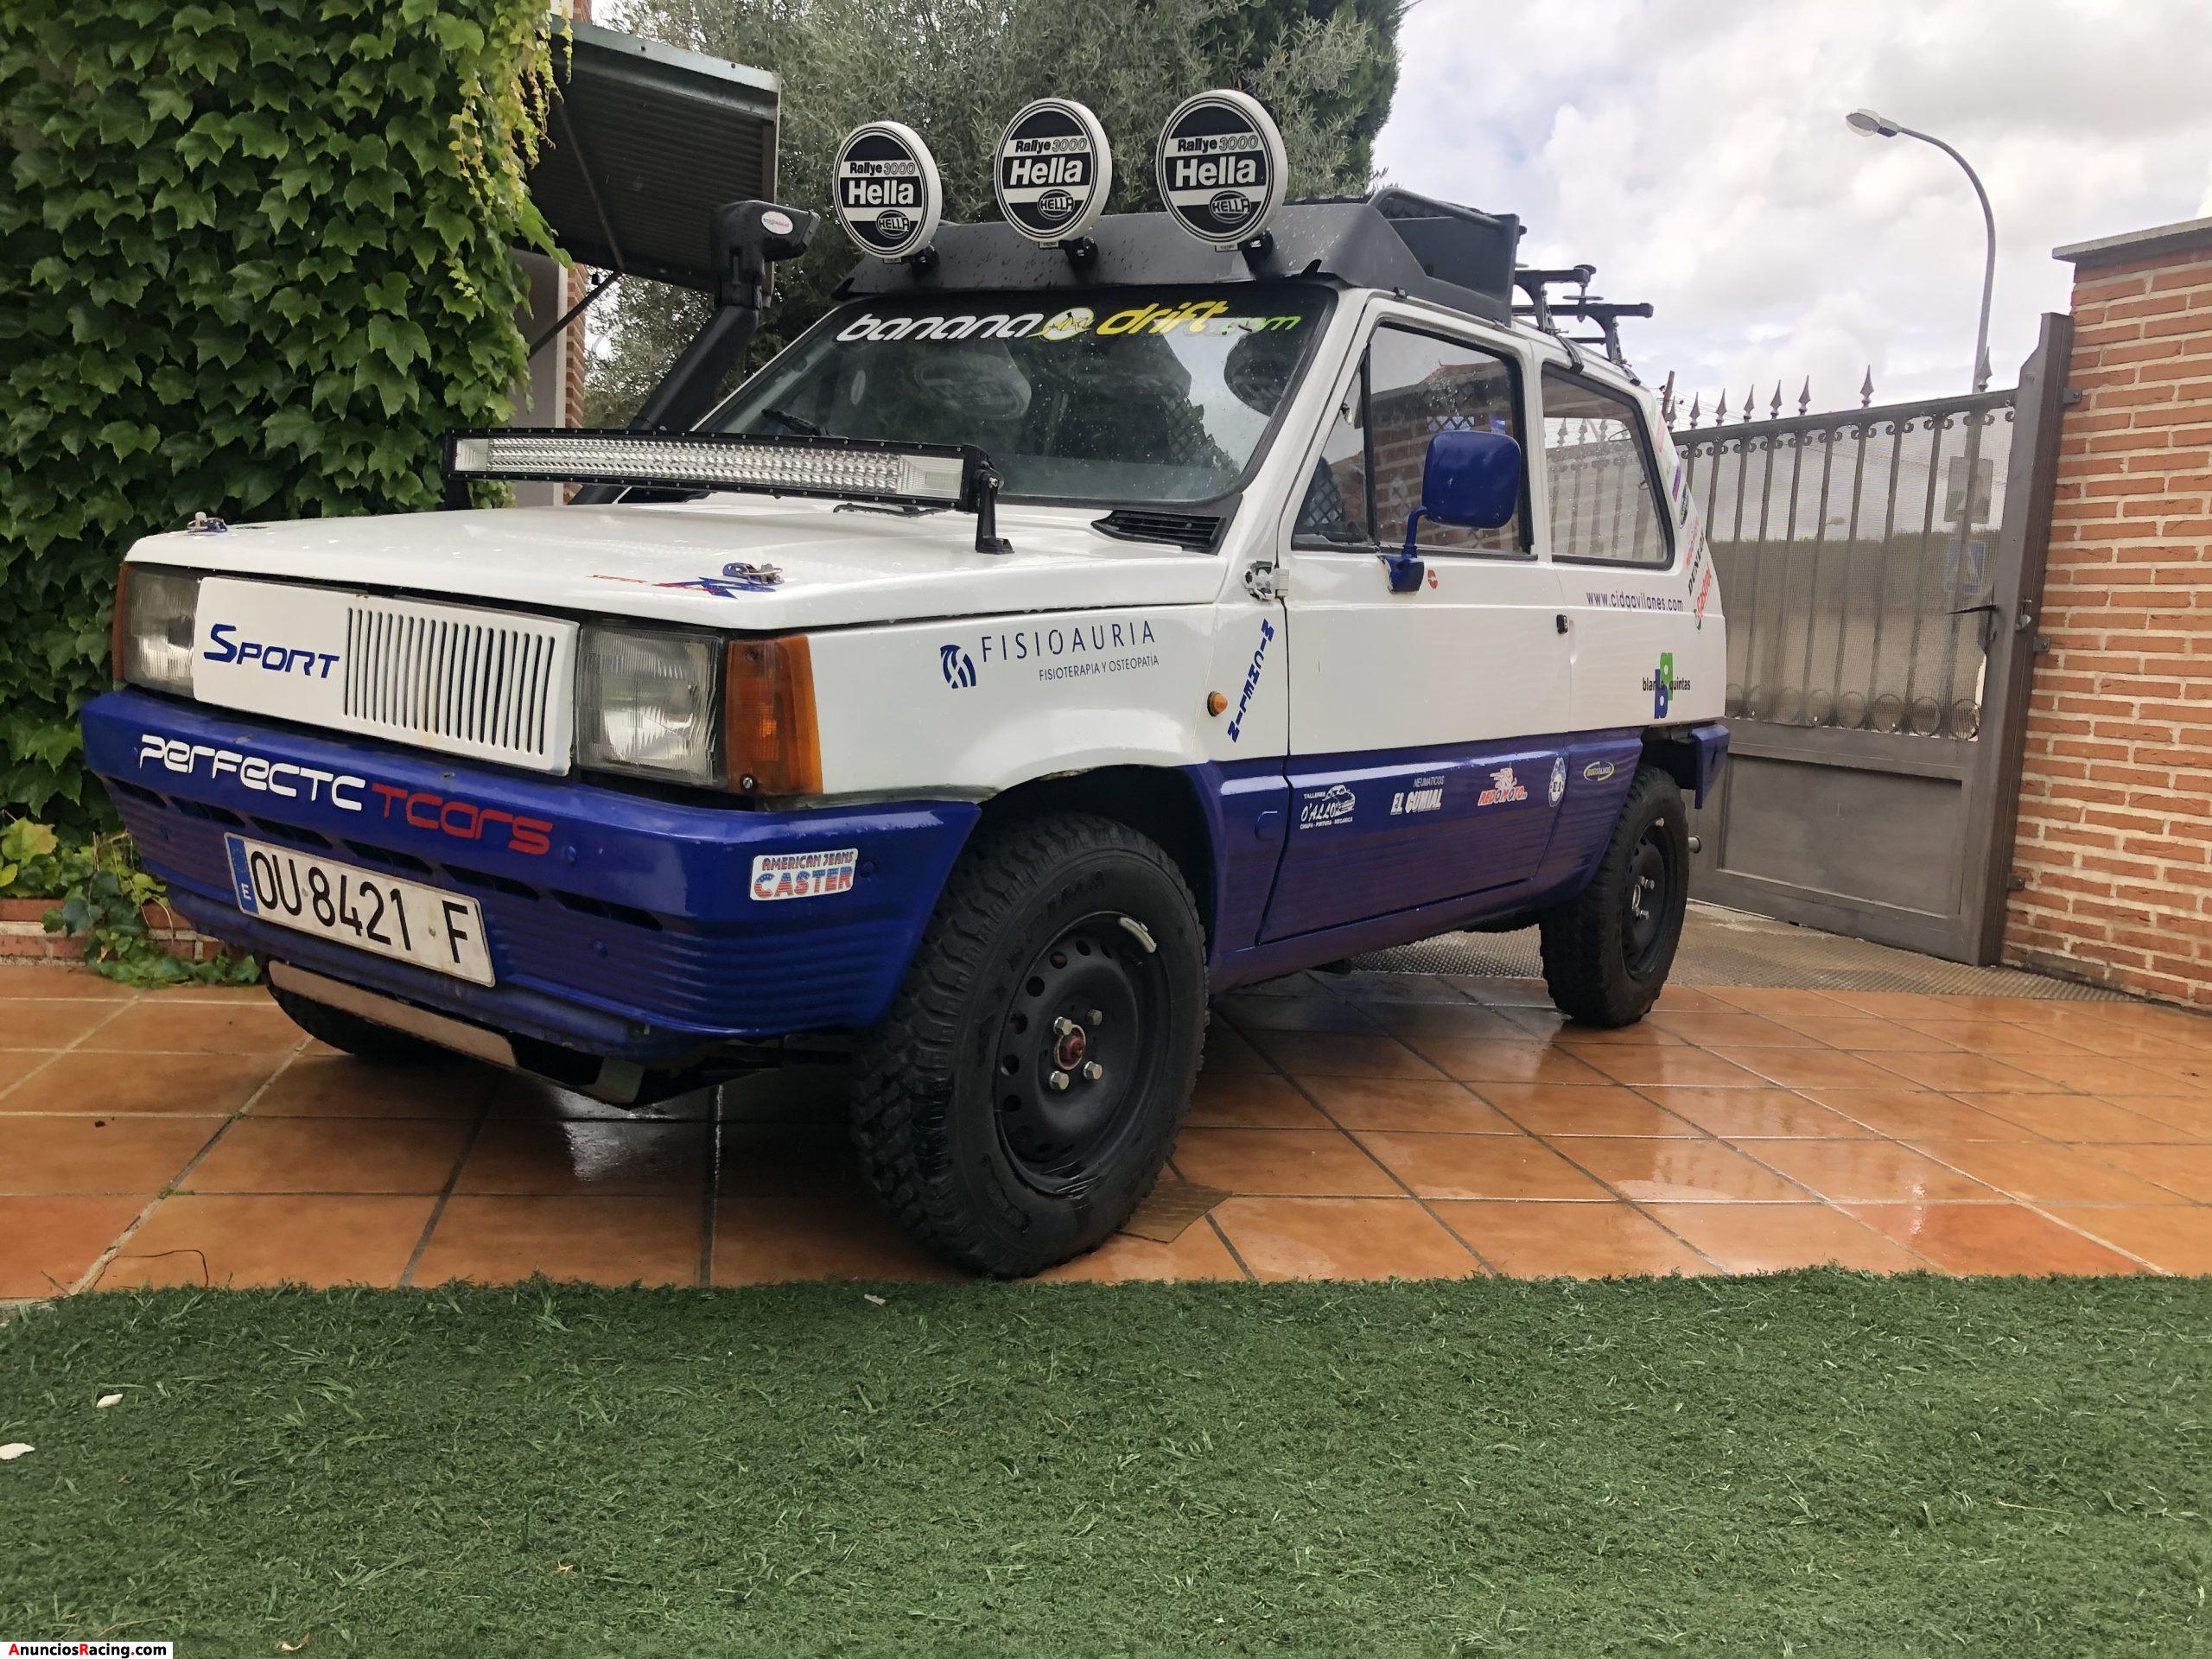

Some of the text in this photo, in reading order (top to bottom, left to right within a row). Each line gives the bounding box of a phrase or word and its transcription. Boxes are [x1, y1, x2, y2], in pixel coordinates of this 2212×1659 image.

[1015, 138, 1087, 154] Rallye 3000
[1178, 135, 1258, 153] Rallye 3000
[849, 162, 916, 175] Rallye 3000
[1010, 157, 1083, 185] Hella
[1175, 156, 1256, 187] Hella
[849, 180, 914, 205] Hella
[1040, 197, 1074, 212] HELLA
[1211, 198, 1250, 213] HELLA
[879, 217, 909, 232] HELLA
[836, 313, 1045, 341] banana
[982, 620, 1155, 663] FISIOAURIA
[1039, 662, 1101, 682] FISIOTERAPIA
[1102, 661, 1107, 673] Y
[1227, 618, 1275, 743] MICHELIN
[1413, 775, 1445, 787] NEUMATICOS
[1390, 791, 1405, 815] EL
[761, 851, 855, 871] AMERICAN JEANS
[241, 883, 251, 900] E
[754, 867, 853, 899] CASTER
[251, 851, 468, 963] OU 8421 F
